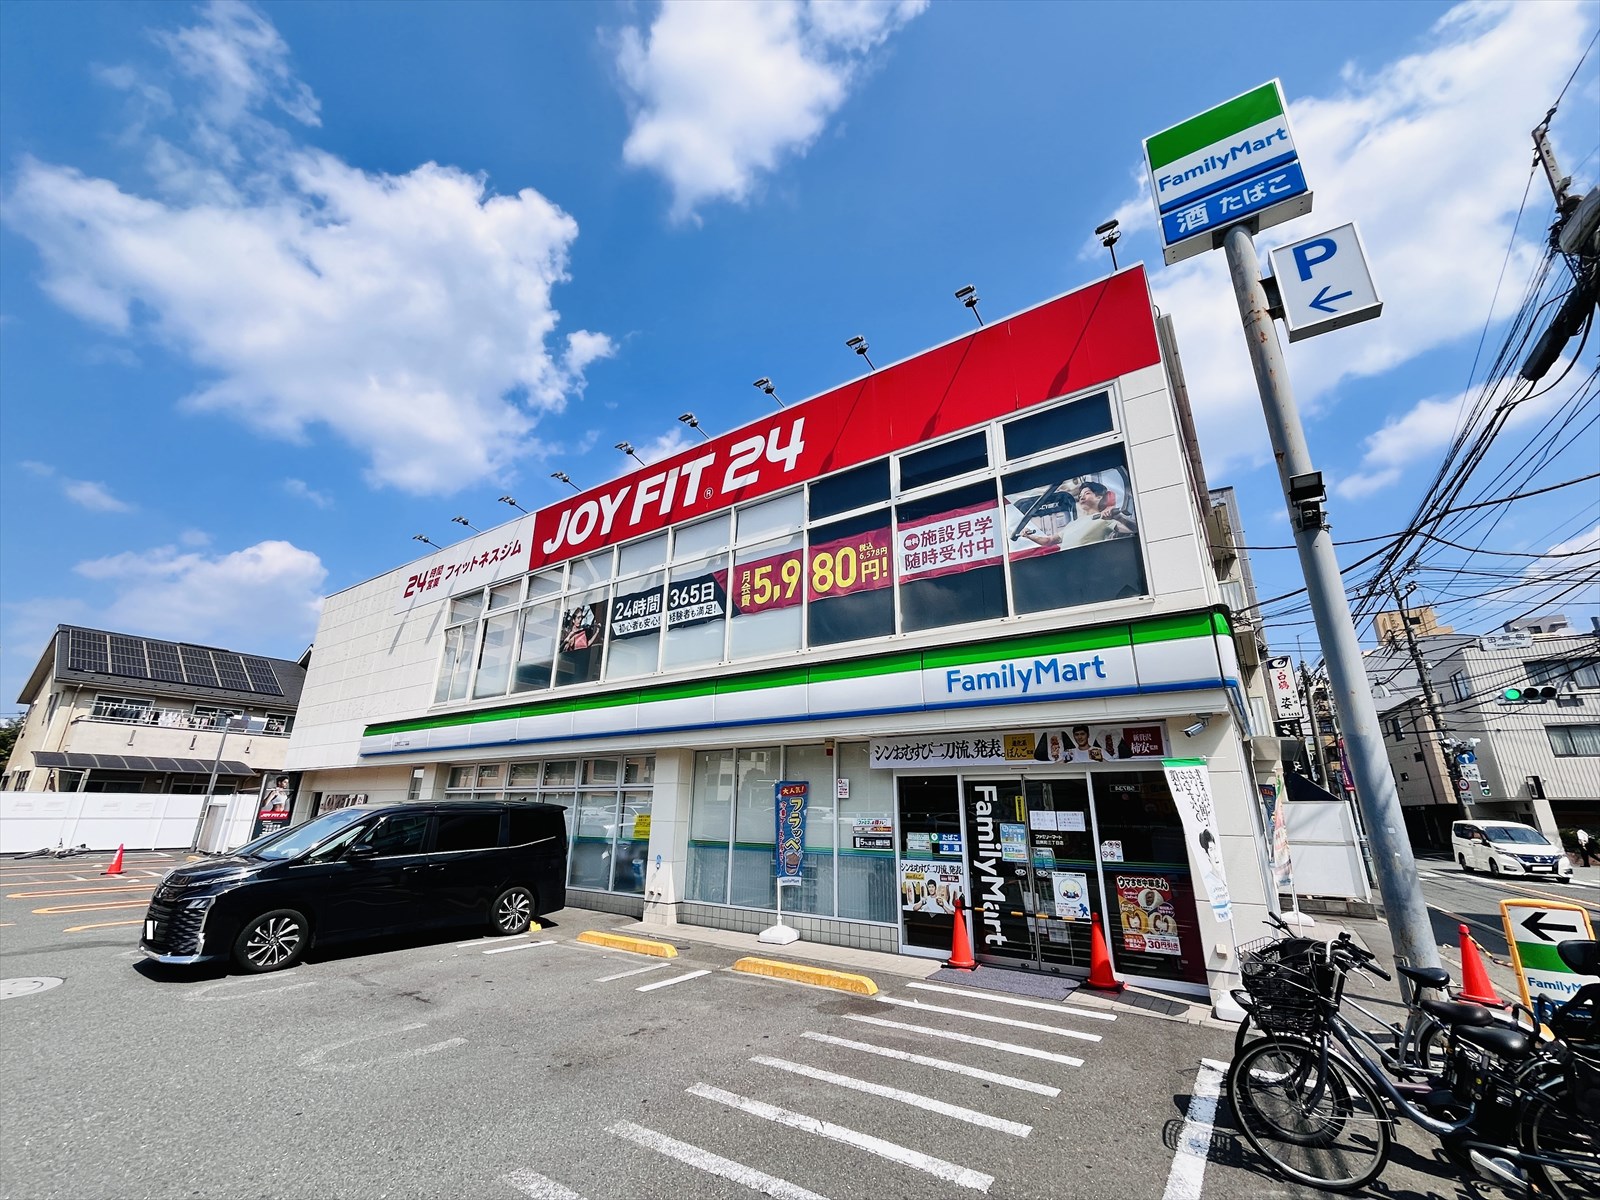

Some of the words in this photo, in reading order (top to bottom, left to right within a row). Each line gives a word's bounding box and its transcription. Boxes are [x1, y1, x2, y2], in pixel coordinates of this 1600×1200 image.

[1158, 127, 1288, 192] FamilyMart
[1176, 202, 1210, 233] 酒
[1219, 173, 1292, 214] たばこ
[1292, 237, 1338, 282] P
[720, 417, 805, 494] 24
[920, 515, 993, 548] 施設見学
[403, 570, 429, 598] 24
[445, 539, 522, 580] フィットネスジム
[859, 546, 888, 560] 6,578円
[904, 536, 994, 571] 随時受付中
[614, 593, 661, 621] 24時間
[670, 581, 715, 608] 365日
[741, 570, 751, 608] 月会費
[946, 654, 1106, 693] FamilyMart
[785, 797, 803, 852] フラッペ
[942, 833, 959, 841] たばこ
[973, 785, 1008, 946] FamilyMart
[1527, 976, 1582, 994] FamilyM
